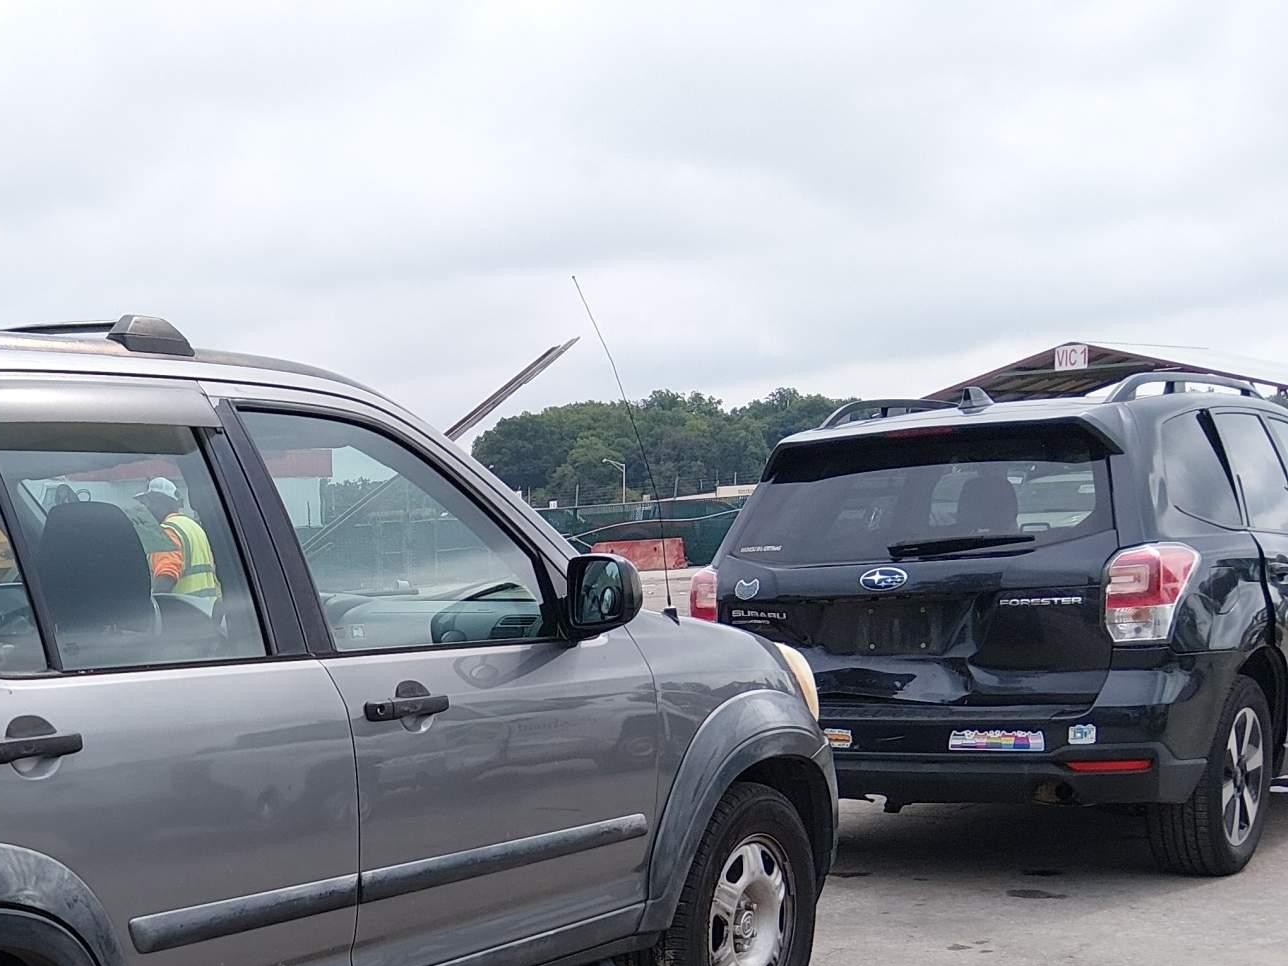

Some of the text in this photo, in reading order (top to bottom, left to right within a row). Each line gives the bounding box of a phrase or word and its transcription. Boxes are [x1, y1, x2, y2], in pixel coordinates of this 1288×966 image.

[1056, 347, 1087, 367] VIC 1
[999, 597, 1082, 606] FORESTER
[732, 610, 787, 620] SUBARU
